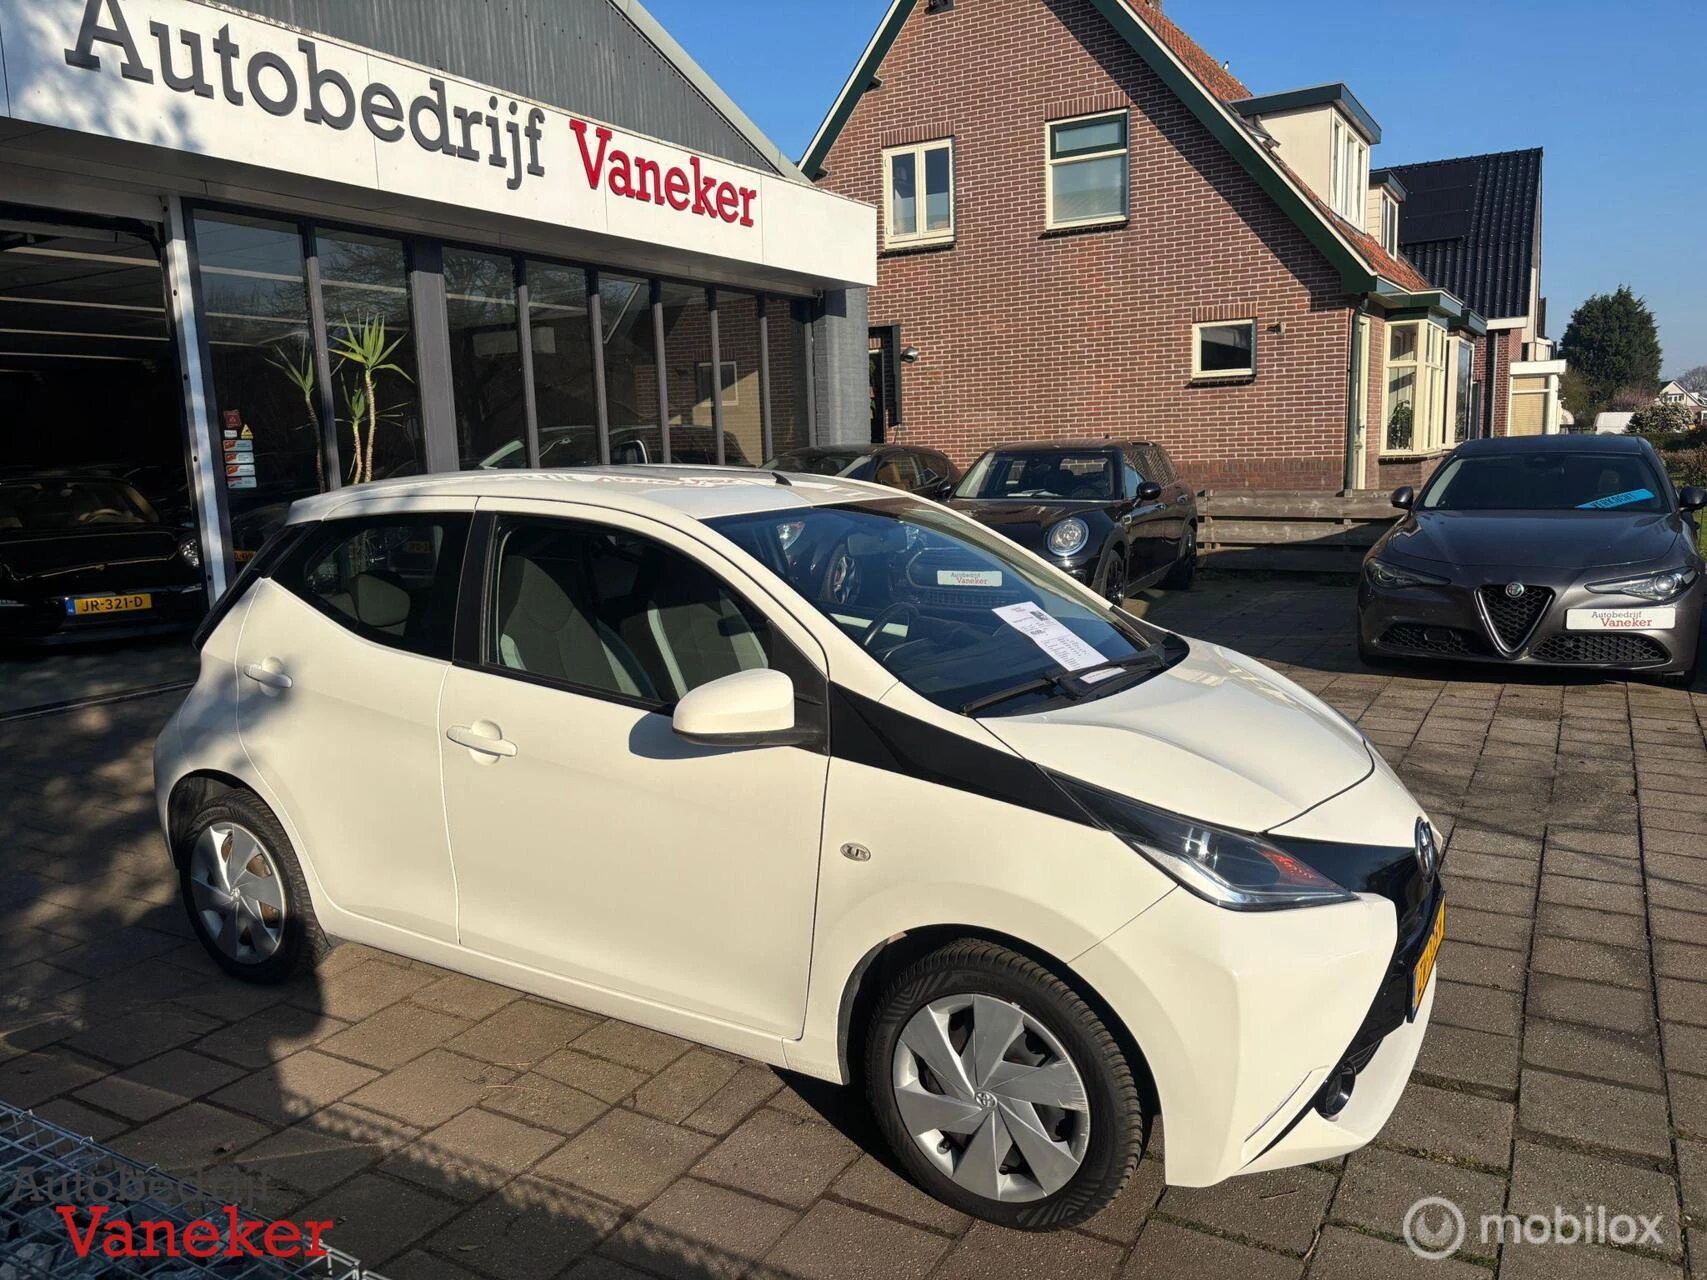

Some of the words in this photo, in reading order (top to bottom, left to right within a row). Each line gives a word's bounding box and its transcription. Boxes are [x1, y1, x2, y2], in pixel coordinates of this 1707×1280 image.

[64, 0, 545, 190] Autobedrijf
[569, 118, 757, 228] Vaneker
[82, 596, 143, 612] JR-321-D
[1591, 611, 1642, 619] Autobedrijf
[1601, 618, 1653, 627] Vaneker
